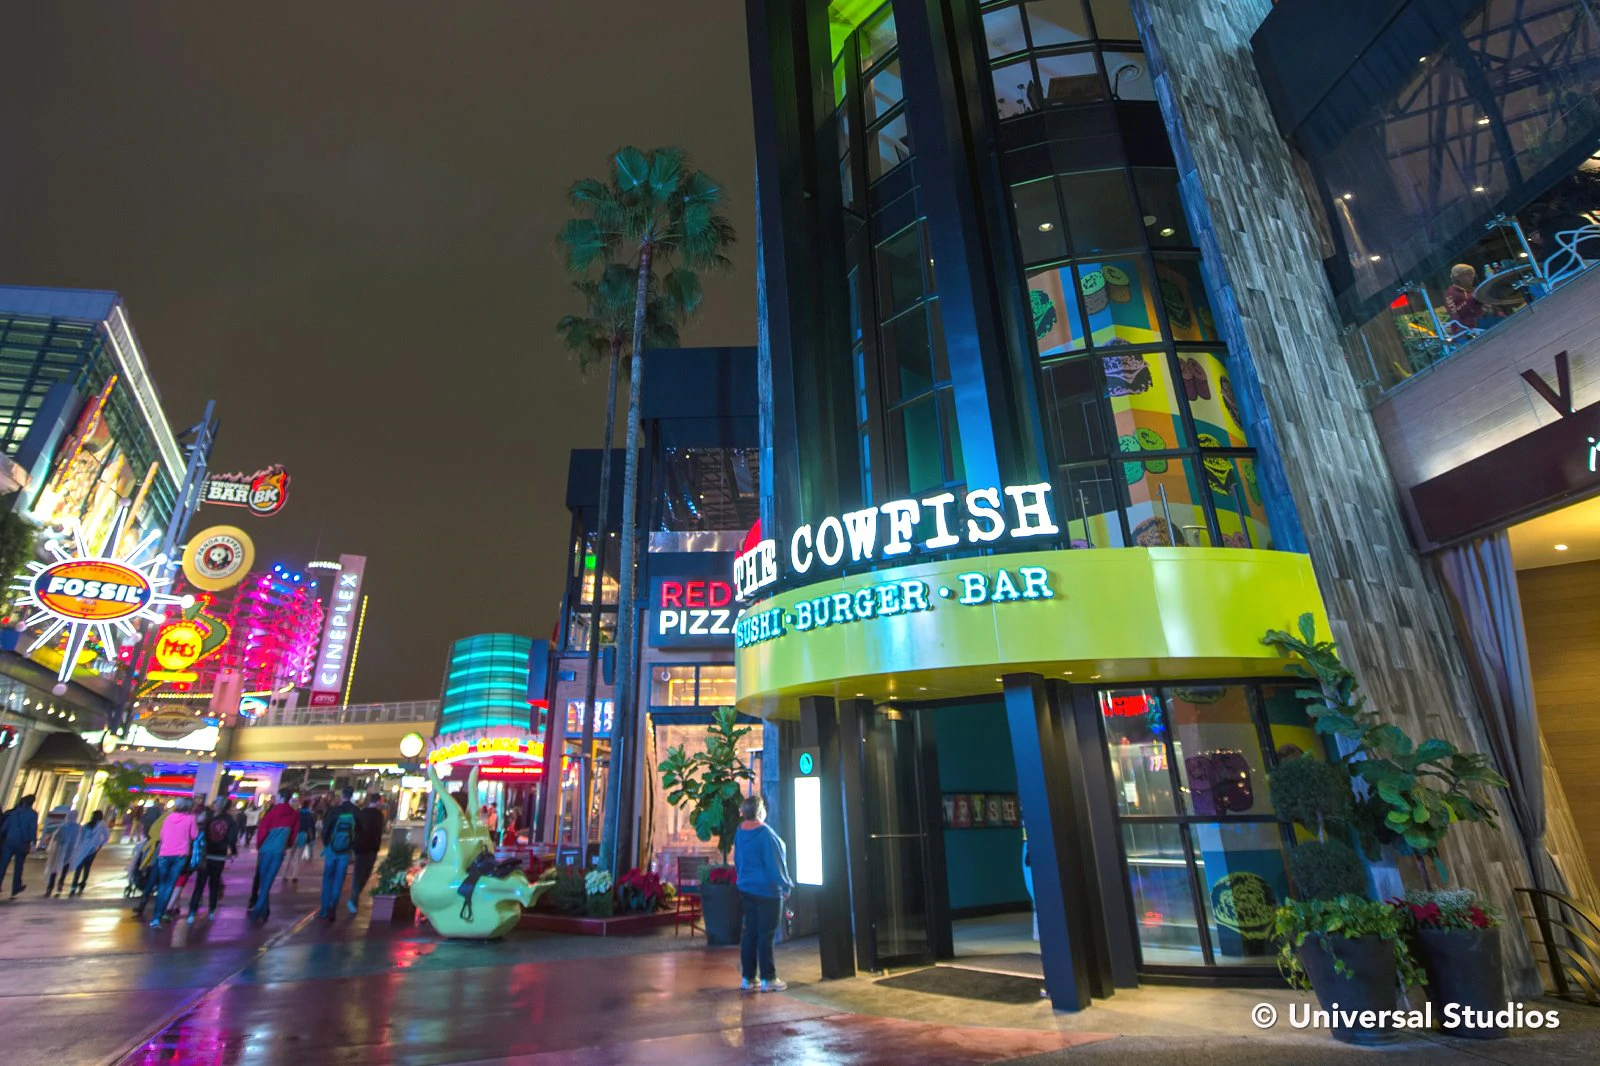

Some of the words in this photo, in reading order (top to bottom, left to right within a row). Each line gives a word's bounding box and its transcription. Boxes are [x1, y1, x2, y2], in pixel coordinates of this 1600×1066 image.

[208, 486, 248, 502] BAR
[253, 488, 279, 504] BK
[197, 538, 219, 556] PANDA
[221, 537, 241, 559] EXPRESS
[733, 538, 777, 602] THE
[791, 482, 1059, 574] COWFISH
[47, 576, 142, 604] FOSSIL
[661, 581, 732, 608] RED
[736, 606, 784, 648] SUSHI
[794, 579, 931, 631] BURGER
[958, 566, 1055, 605] BAR
[321, 573, 358, 685] CINEPLEX
